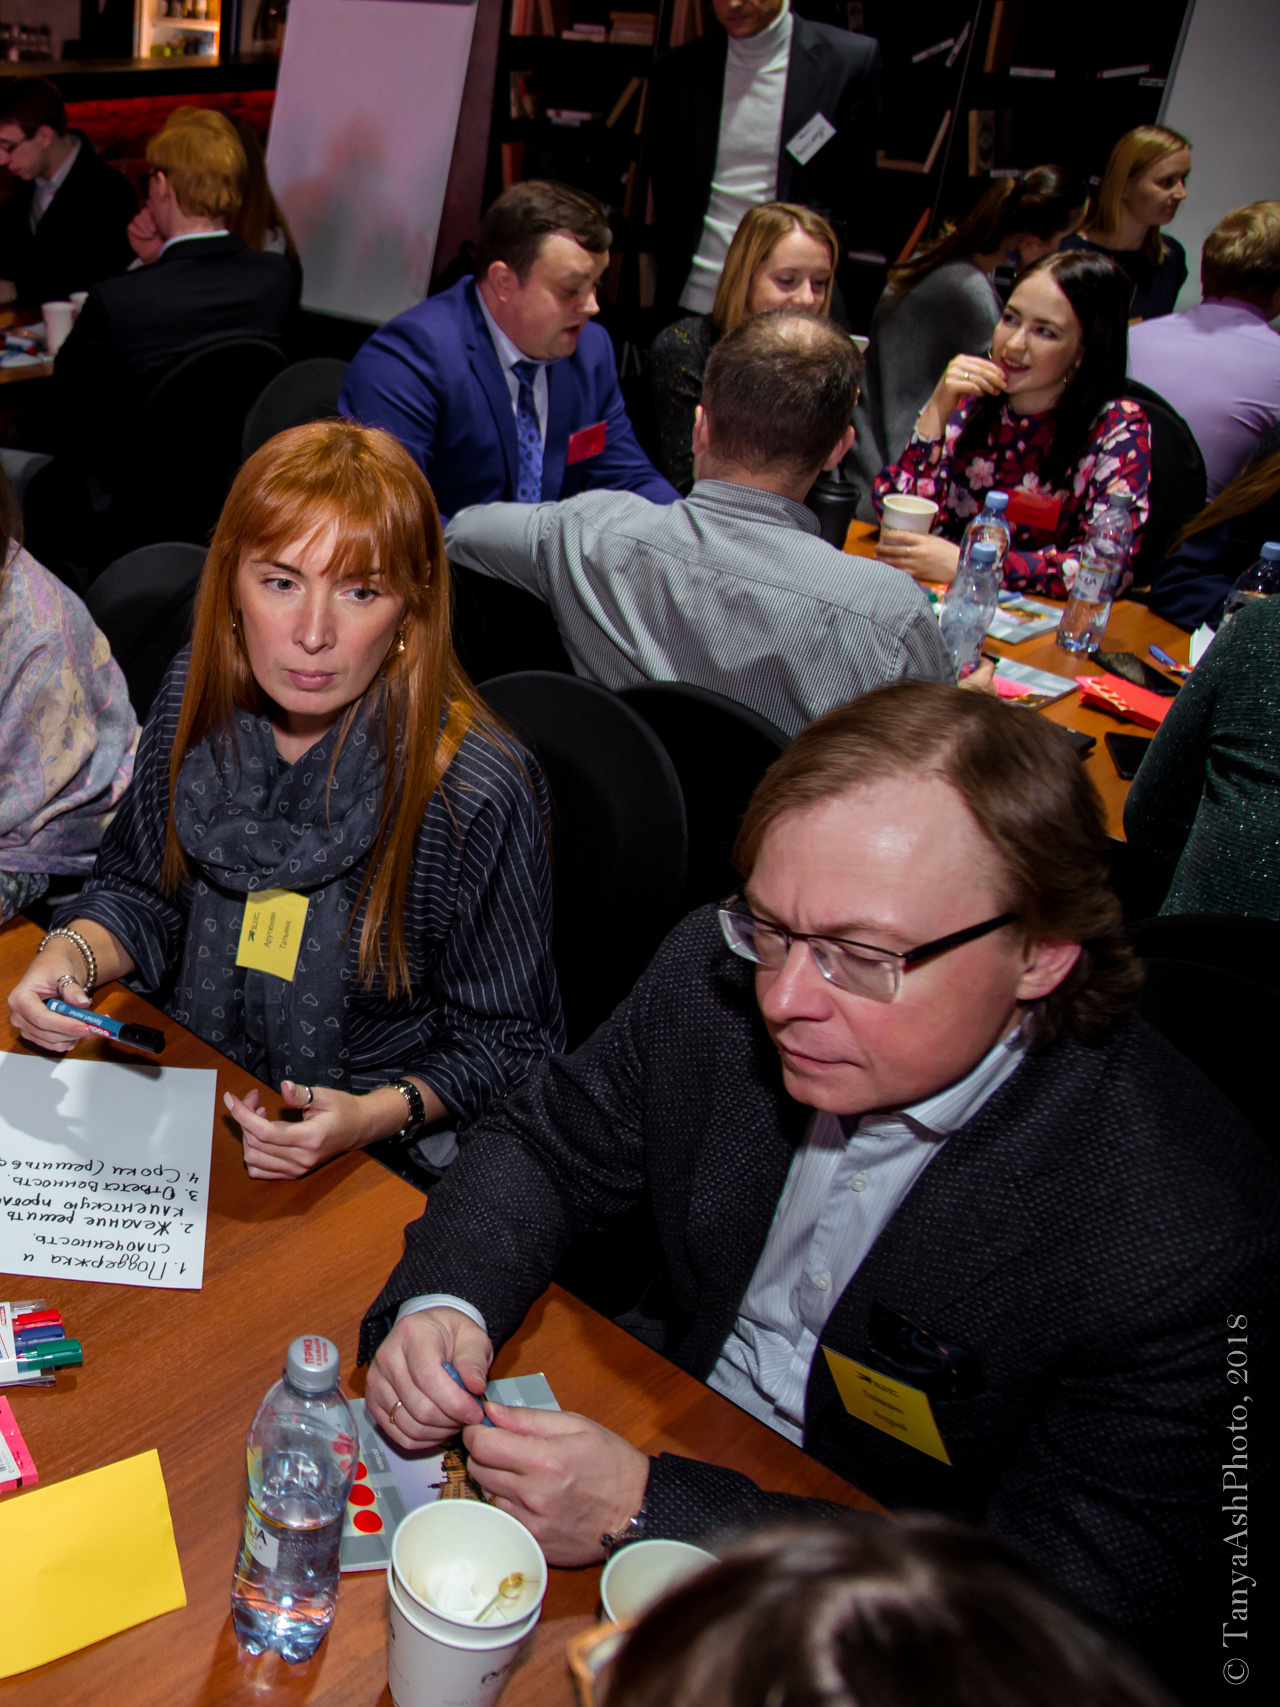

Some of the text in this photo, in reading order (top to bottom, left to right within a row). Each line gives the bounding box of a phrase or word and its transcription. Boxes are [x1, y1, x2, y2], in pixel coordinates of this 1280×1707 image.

[113, 1164, 181, 1184] Сроки
[63, 1196, 184, 1218] клиентскую
[185, 1188, 199, 1202] 3.
[7, 1210, 194, 1236] 2. Желание решить
[23, 1252, 187, 1281] 1. Поддержка и
[303, 1339, 315, 1365] ПРИЗ
